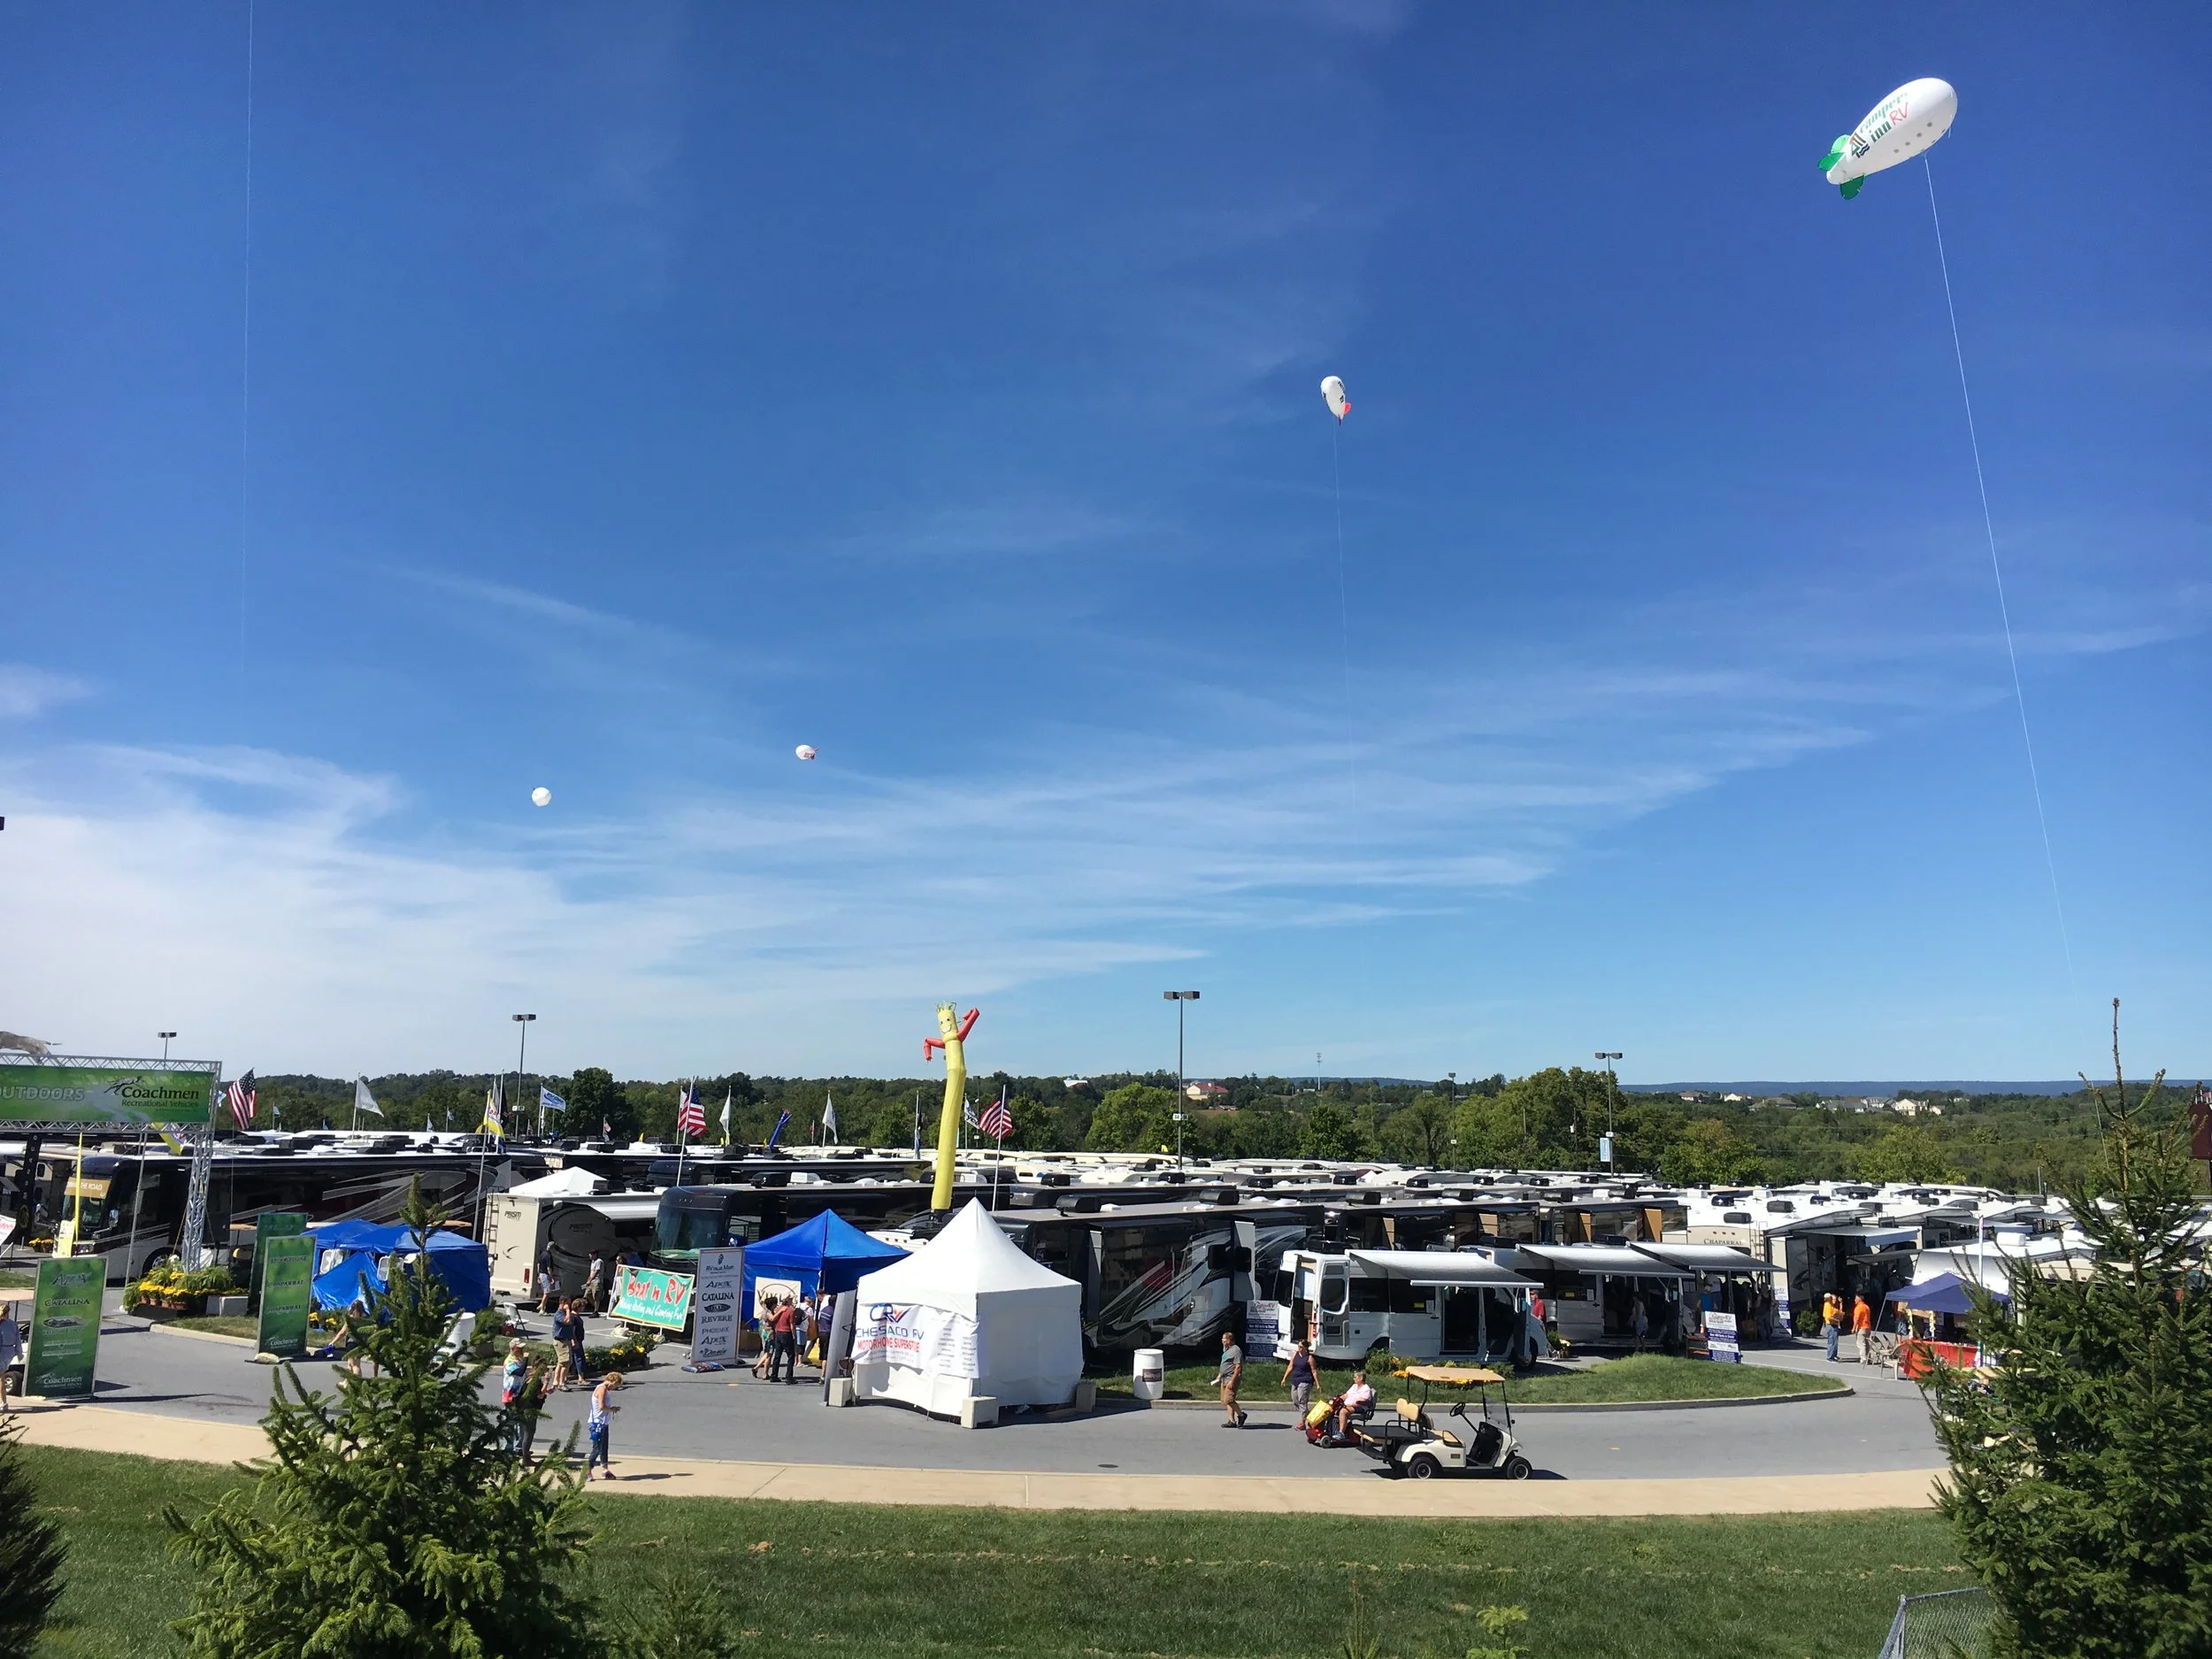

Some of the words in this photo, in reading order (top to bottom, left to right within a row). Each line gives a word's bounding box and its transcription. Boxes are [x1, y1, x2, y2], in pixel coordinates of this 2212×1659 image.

[1869, 120, 1892, 143] inn
[1889, 102, 1909, 126] RV
[121, 1086, 199, 1100] Coachmen
[627, 1274, 651, 1301] Boat
[651, 1285, 661, 1302] n
[664, 1277, 686, 1307] RV
[702, 1292, 734, 1301] CATALINA
[44, 1298, 90, 1307] CATALINA
[701, 1315, 733, 1324] REVERE
[856, 1325, 908, 1338] CHESACO
[912, 1328, 925, 1340] RV
[43, 1376, 82, 1385] Coachmen
